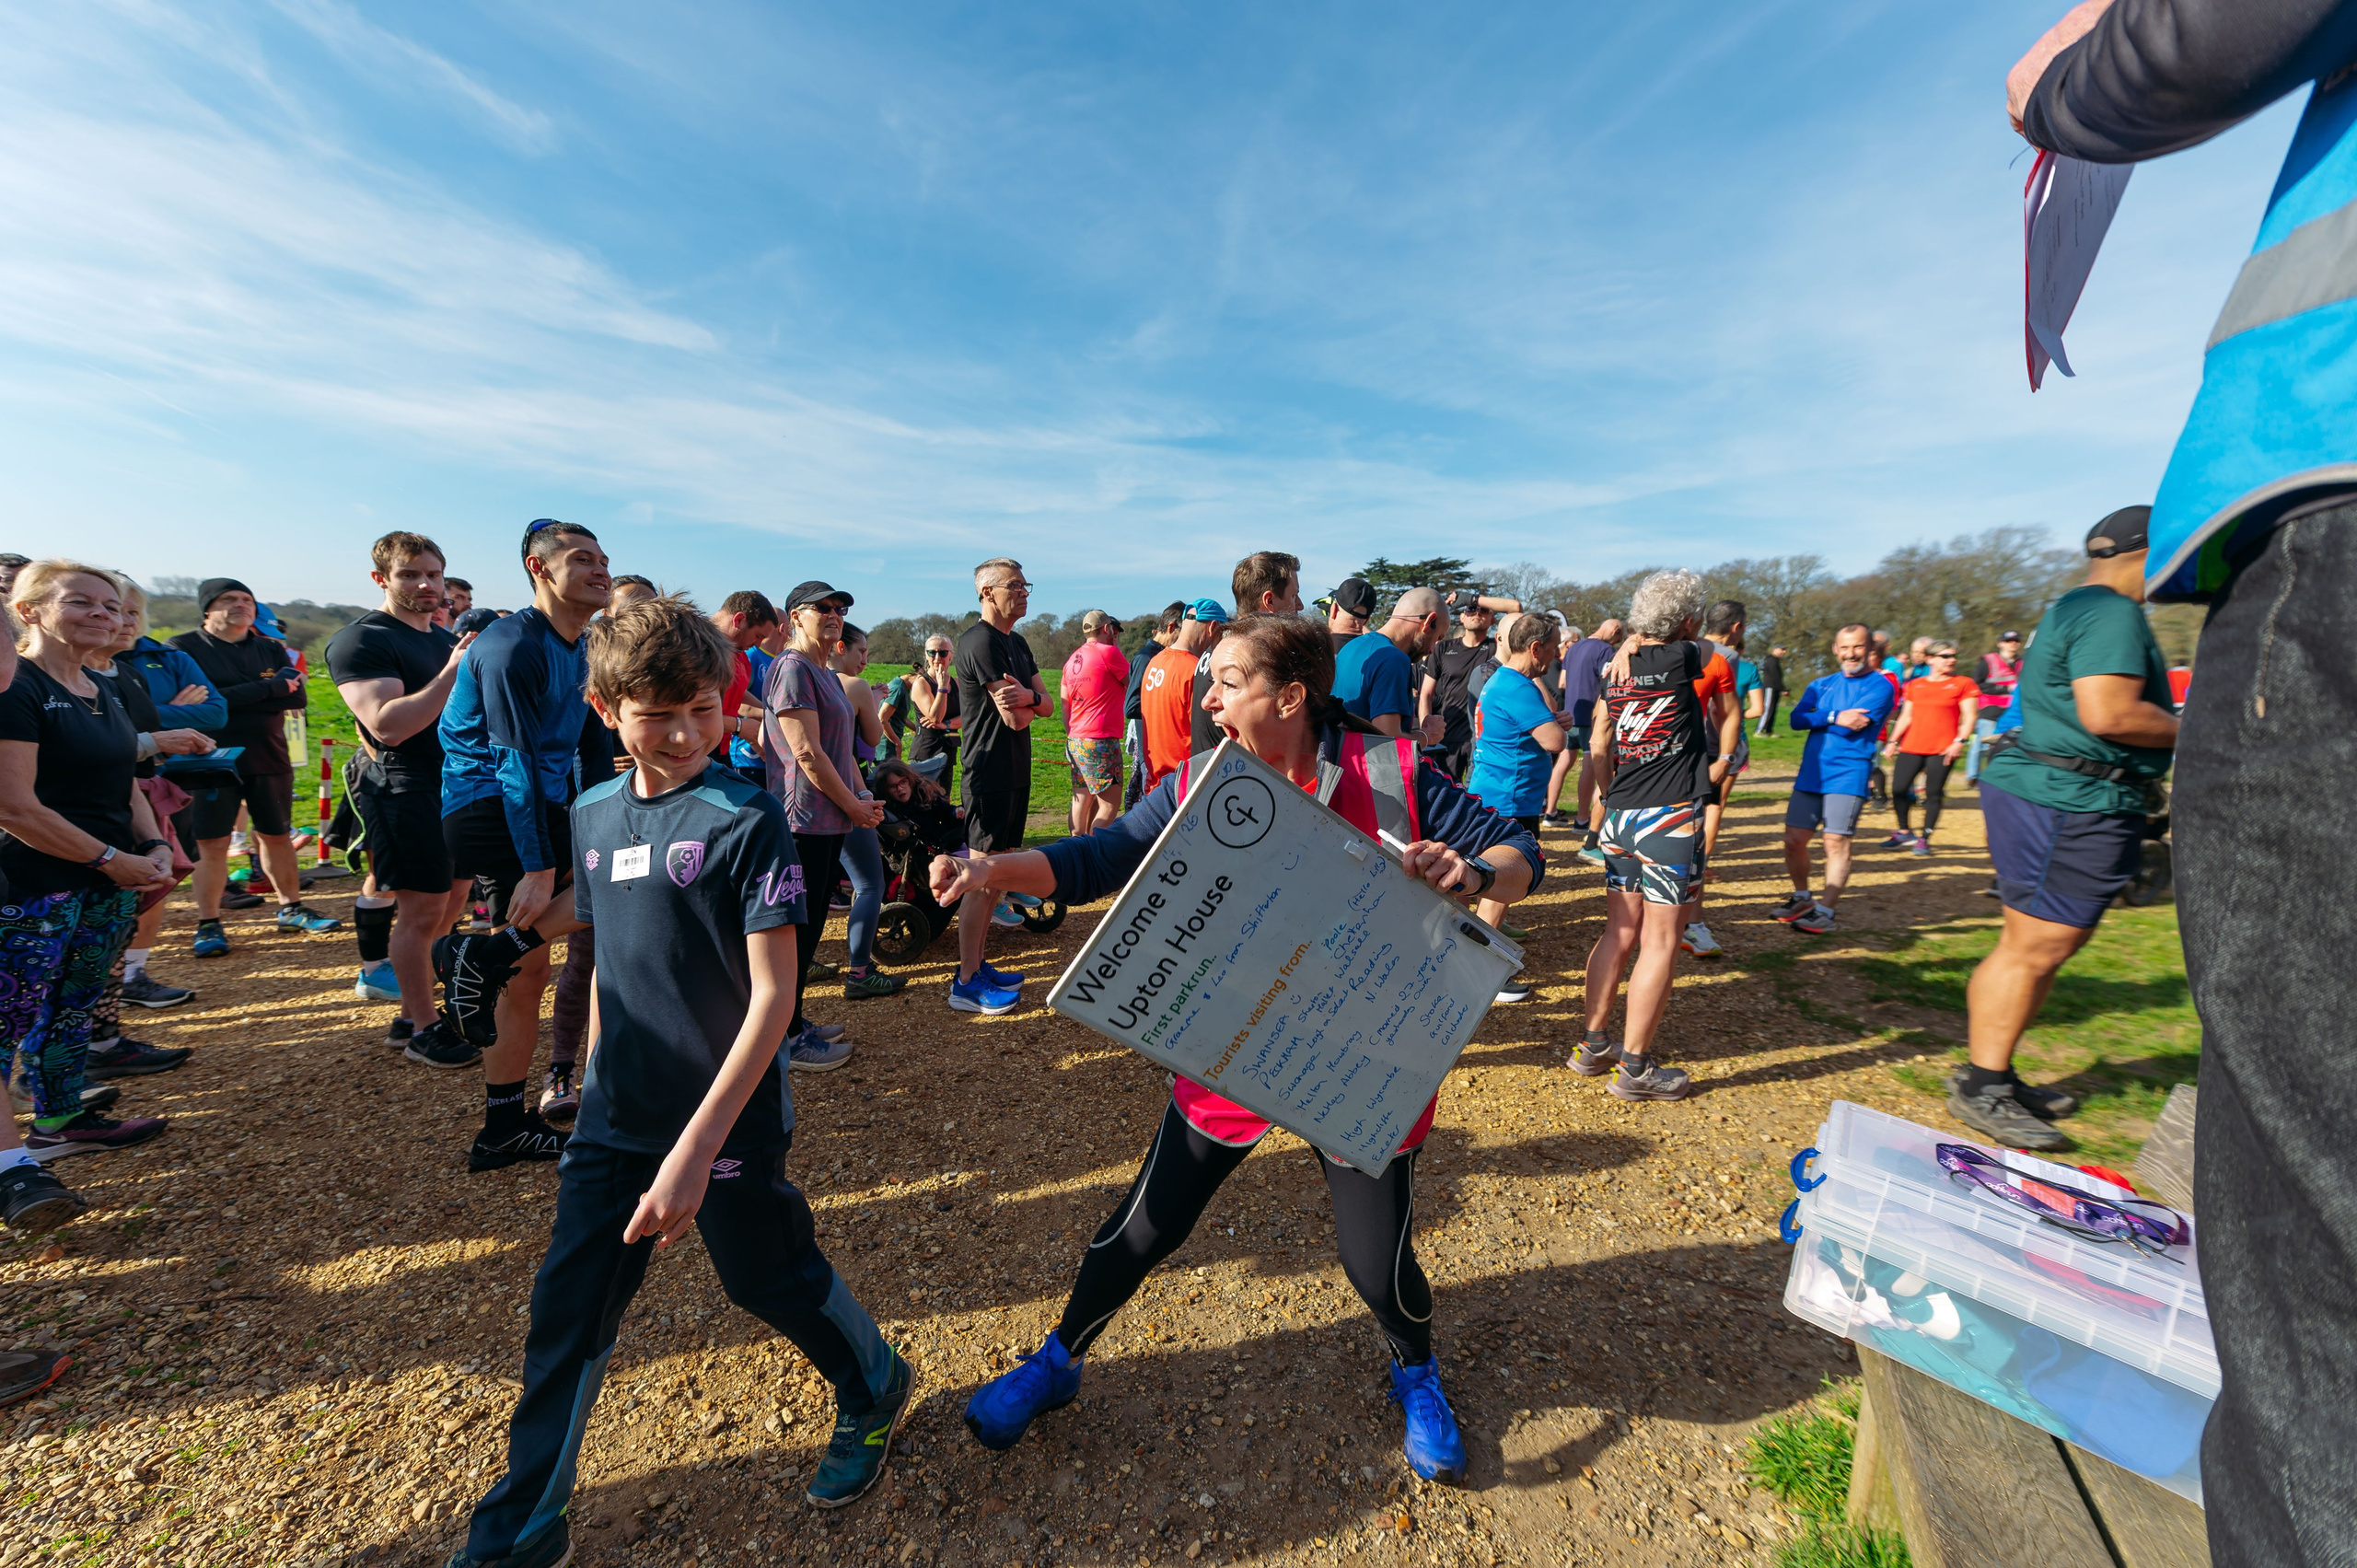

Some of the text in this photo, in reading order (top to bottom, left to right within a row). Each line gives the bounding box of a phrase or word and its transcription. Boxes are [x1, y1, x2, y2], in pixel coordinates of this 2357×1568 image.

[1145, 667, 1166, 691] 50
[1640, 742, 1684, 764] HAF
[1068, 858, 1188, 1004] Welcome to
[1324, 923, 1347, 950] Poole
[1108, 875, 1232, 1029] Upton House
[1348, 942, 1392, 991] Reading
[1211, 969, 1226, 987] Leo
[1140, 1013, 1173, 1046] First
[1202, 1028, 1249, 1080] Tourists
[1245, 977, 1287, 1027] visiting
[1241, 1015, 1287, 1080] SWANSEA
[1258, 1036, 1304, 1090] PECKHAM
[1278, 1044, 1320, 1100] Swanage
[1340, 1054, 1371, 1086] Abbey
[487, 1092, 524, 1107] EVERLAST
[1340, 1065, 1401, 1142] High Wycombe
[713, 1171, 740, 1179] umbro
[2102, 1214, 2145, 1231] parkun
